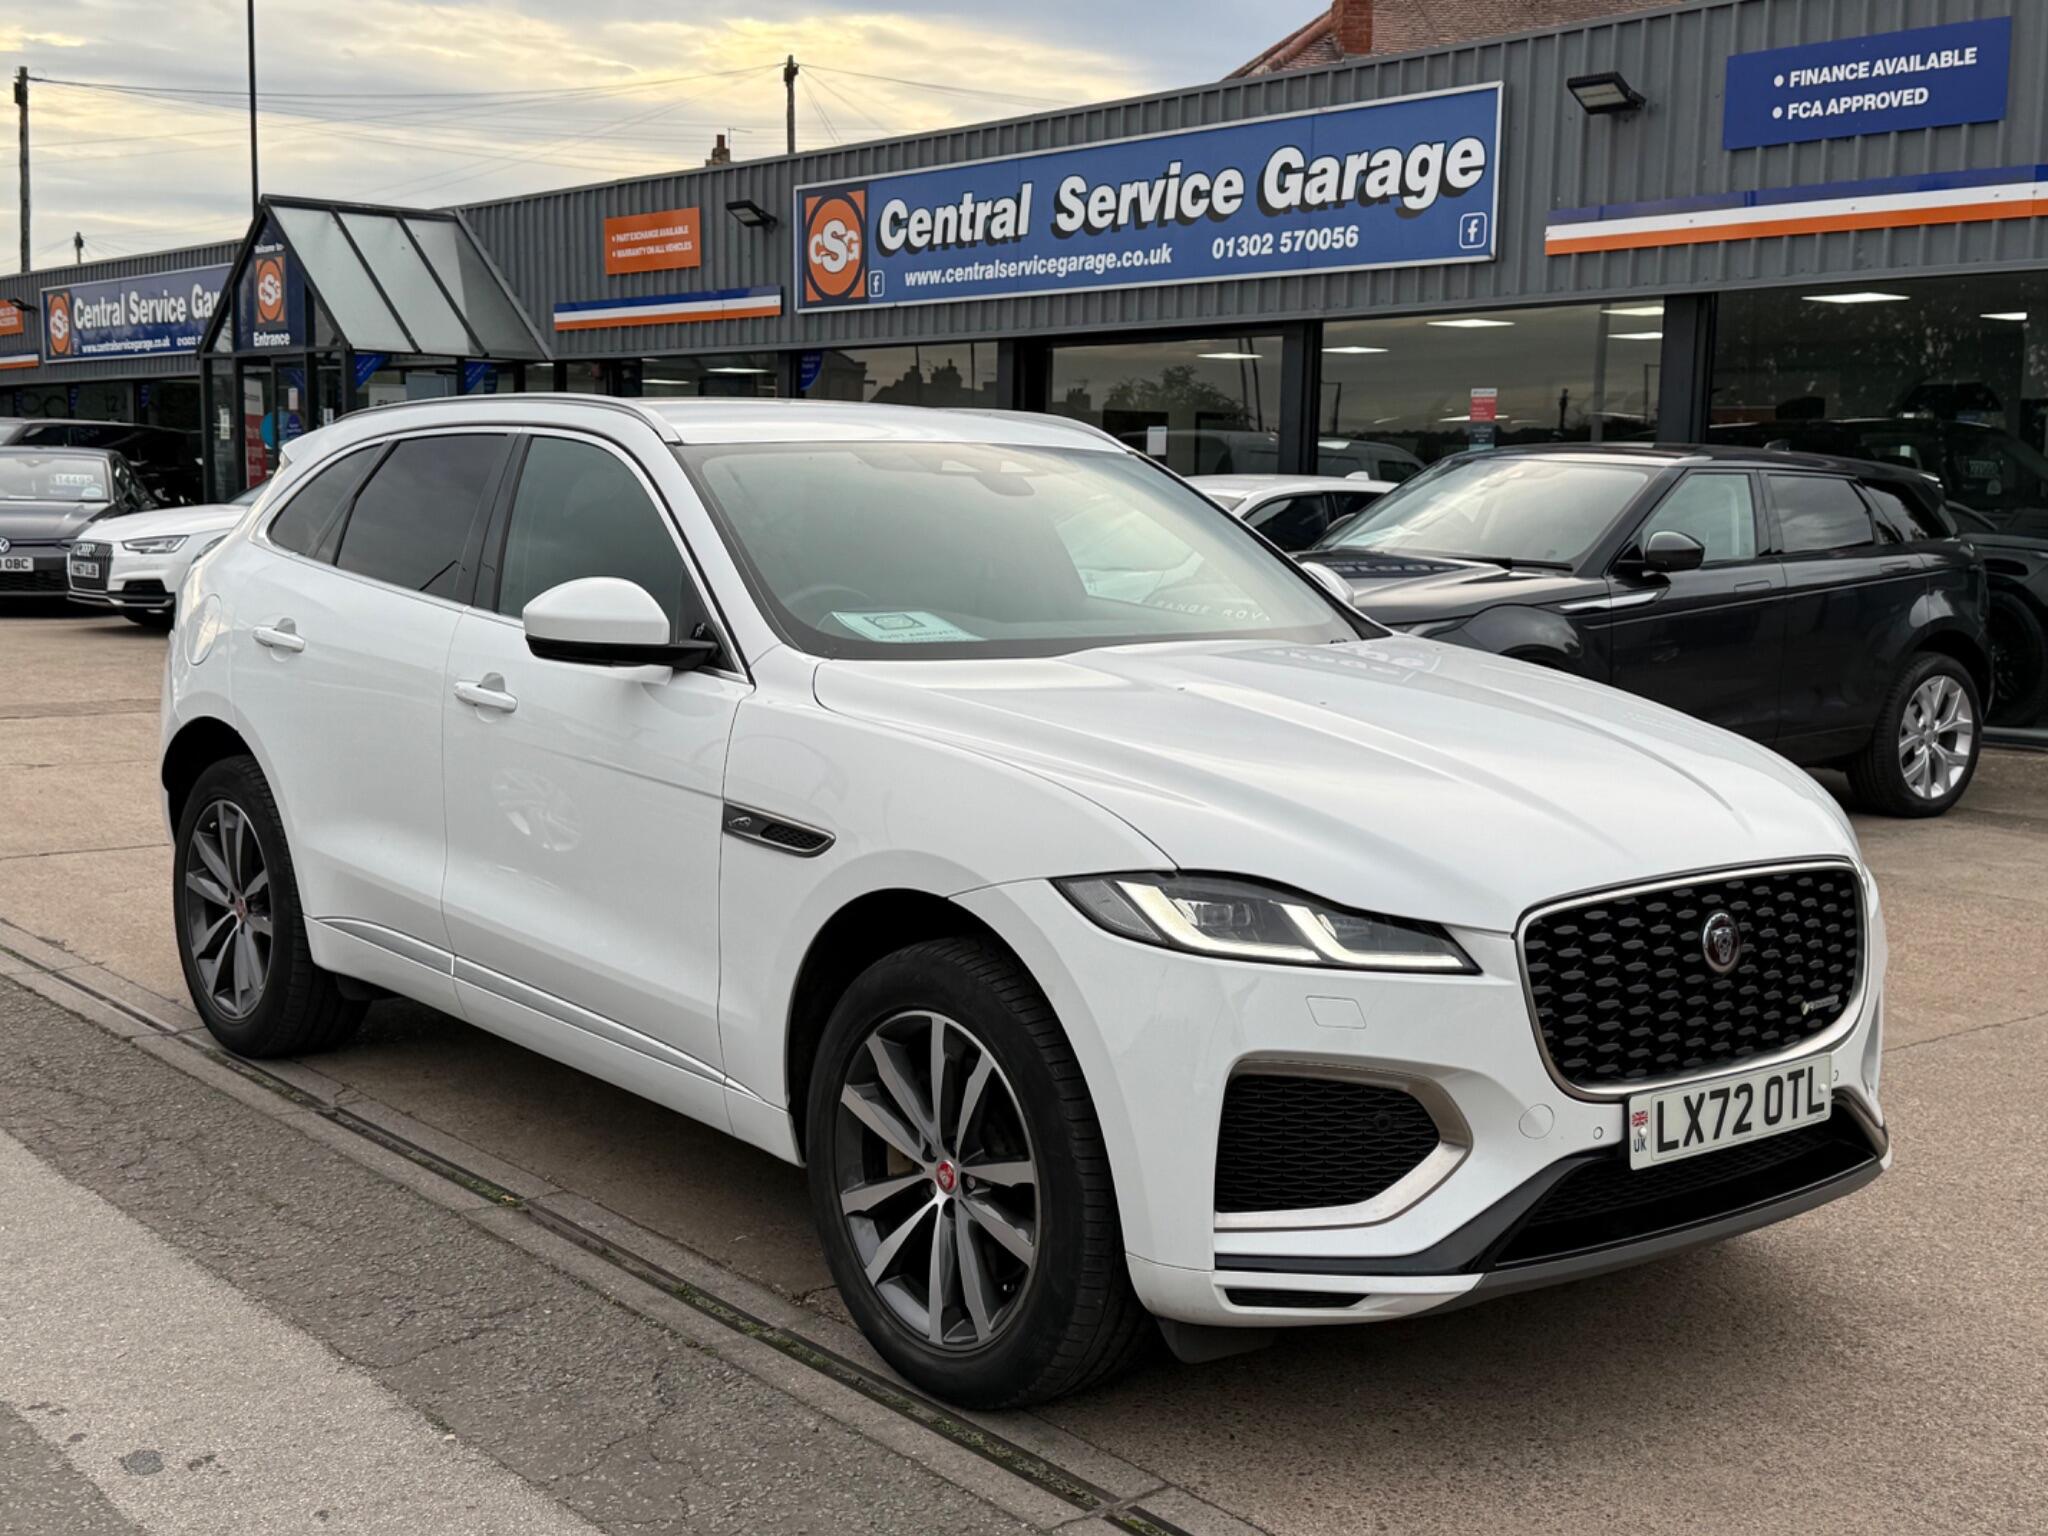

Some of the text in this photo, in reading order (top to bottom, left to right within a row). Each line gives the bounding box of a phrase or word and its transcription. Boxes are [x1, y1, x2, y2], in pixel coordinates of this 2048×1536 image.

[1789, 46, 1978, 88] FINANCE AVAILABLE
[1787, 87, 1930, 120] FCA APPROVED
[878, 136, 1486, 252] Central Service Garage
[810, 219, 860, 273] CSG
[1211, 225, 1360, 259] 01302 570056
[904, 242, 1173, 287] www.centralservicegarage.co.uk
[73, 293, 126, 330] Central
[128, 290, 187, 325] Service
[253, 332, 290, 347] Entrance
[1656, 1066, 1825, 1153] LX72 OTL
[1634, 1137, 1648, 1153] UK
